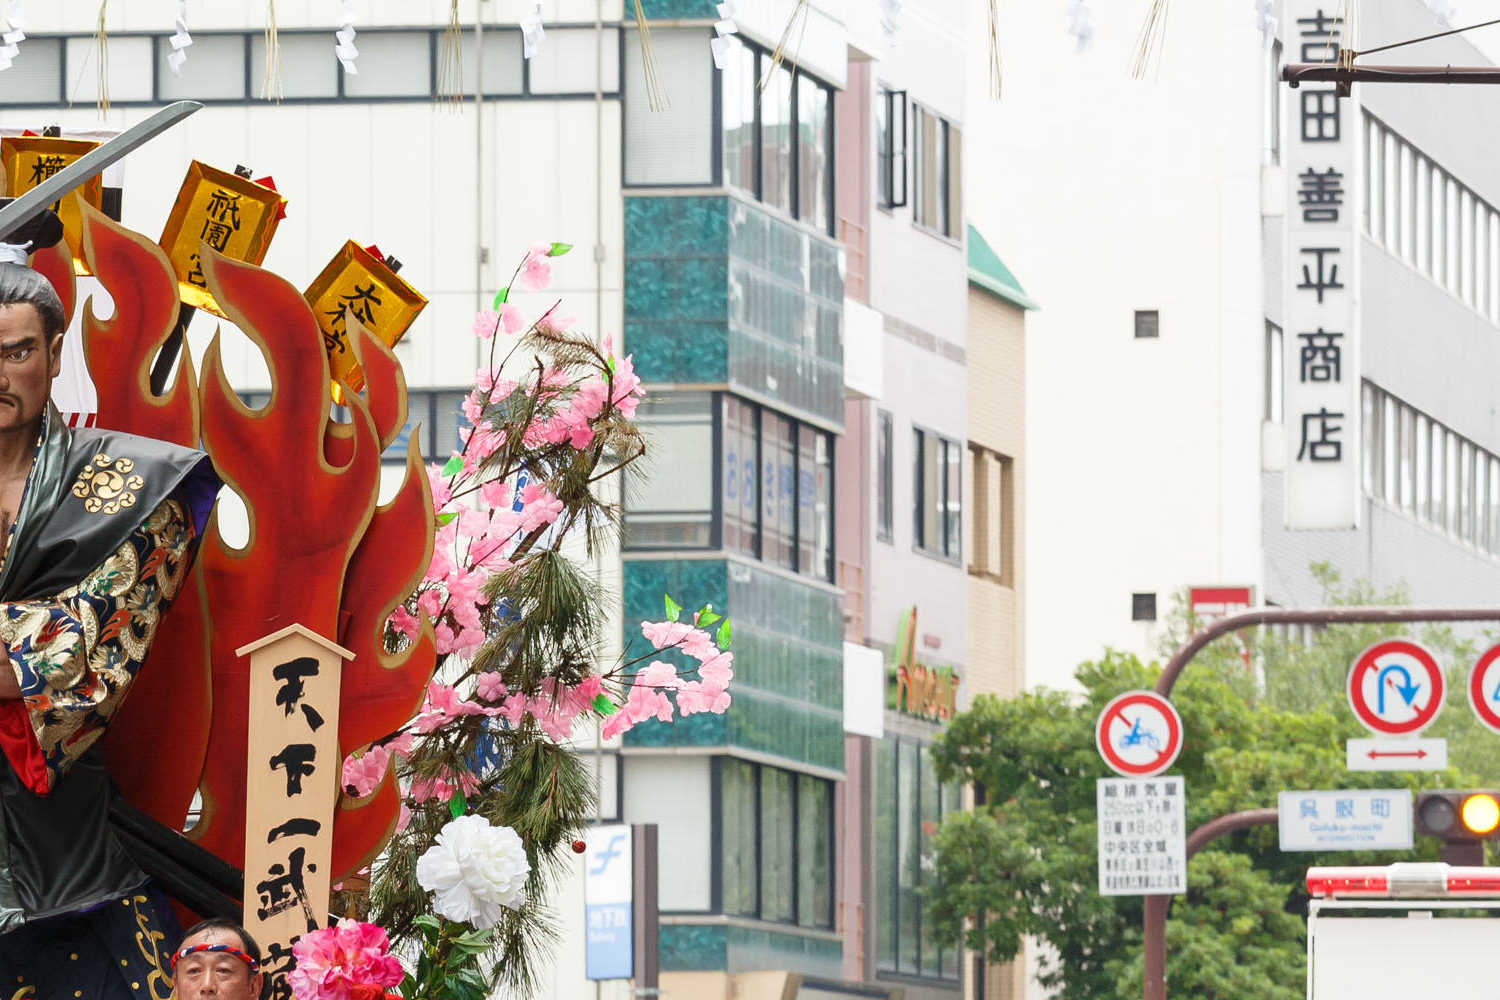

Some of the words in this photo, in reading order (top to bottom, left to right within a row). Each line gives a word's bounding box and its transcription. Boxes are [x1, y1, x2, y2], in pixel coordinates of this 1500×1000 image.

[1296, 8, 1344, 463] 吉田善平商店
[1299, 797, 1390, 818] 呉服町
